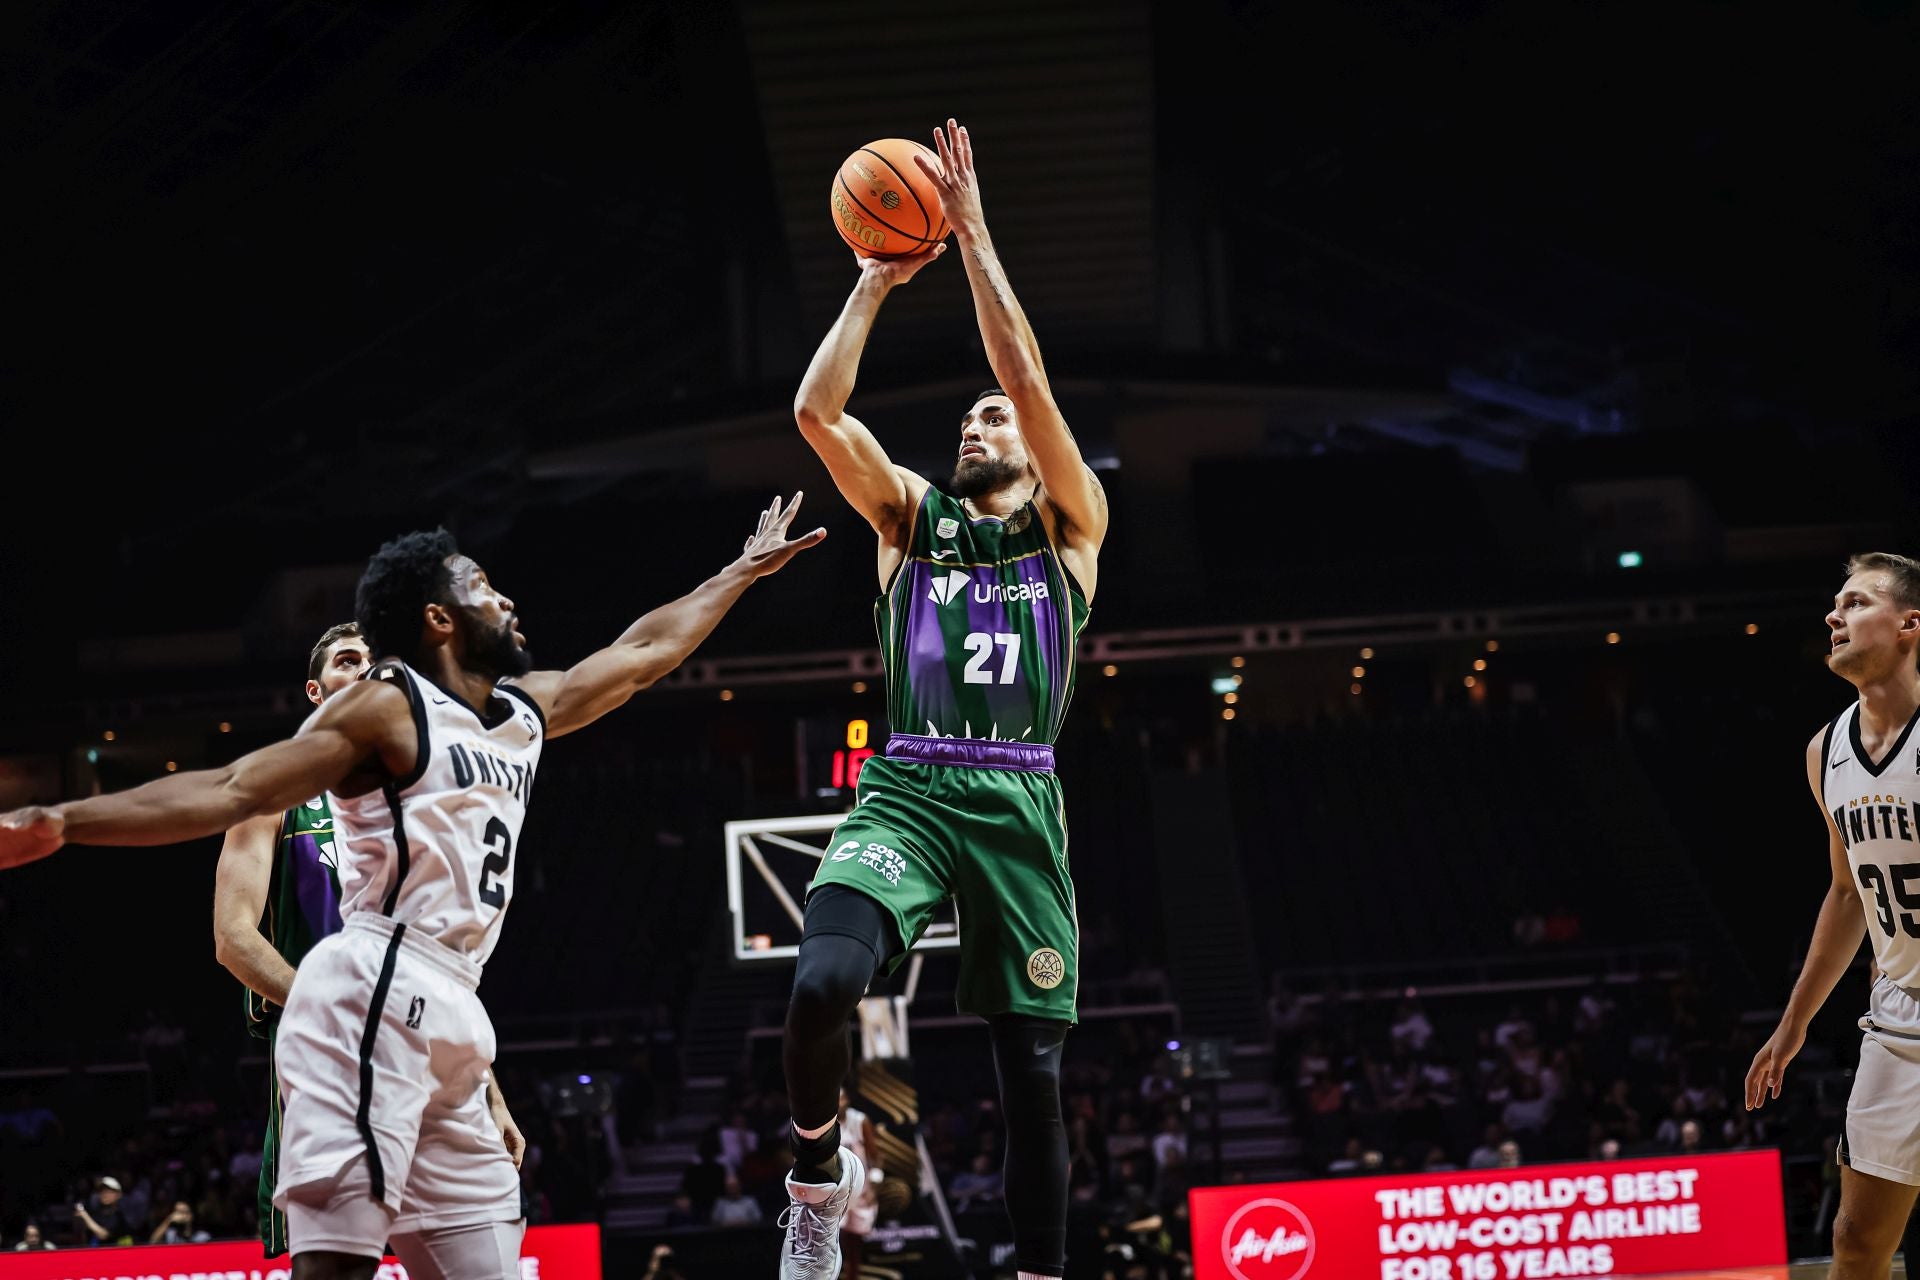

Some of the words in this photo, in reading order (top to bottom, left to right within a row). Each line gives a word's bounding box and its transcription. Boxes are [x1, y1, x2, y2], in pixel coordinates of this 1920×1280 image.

[974, 576, 1050, 606] Unicaja
[962, 631, 1021, 686] 27
[1833, 801, 1920, 850] UNITE
[478, 815, 513, 911] 2
[861, 849, 884, 864] DEL
[884, 860, 902, 880] SOL
[867, 842, 907, 873] COSTA
[1857, 862, 1920, 939] 35
[1374, 1185, 1446, 1220] THE
[1447, 1174, 1609, 1215] WORLD'S
[1611, 1168, 1699, 1204] BEST
[1230, 1225, 1308, 1266] AirAsia
[1378, 1212, 1564, 1255] LOW-COST
[1567, 1202, 1702, 1242] AIRLINE
[1380, 1255, 1454, 1280] FOR
[1455, 1250, 1498, 1280] 16
[1499, 1243, 1615, 1280] YEARS
